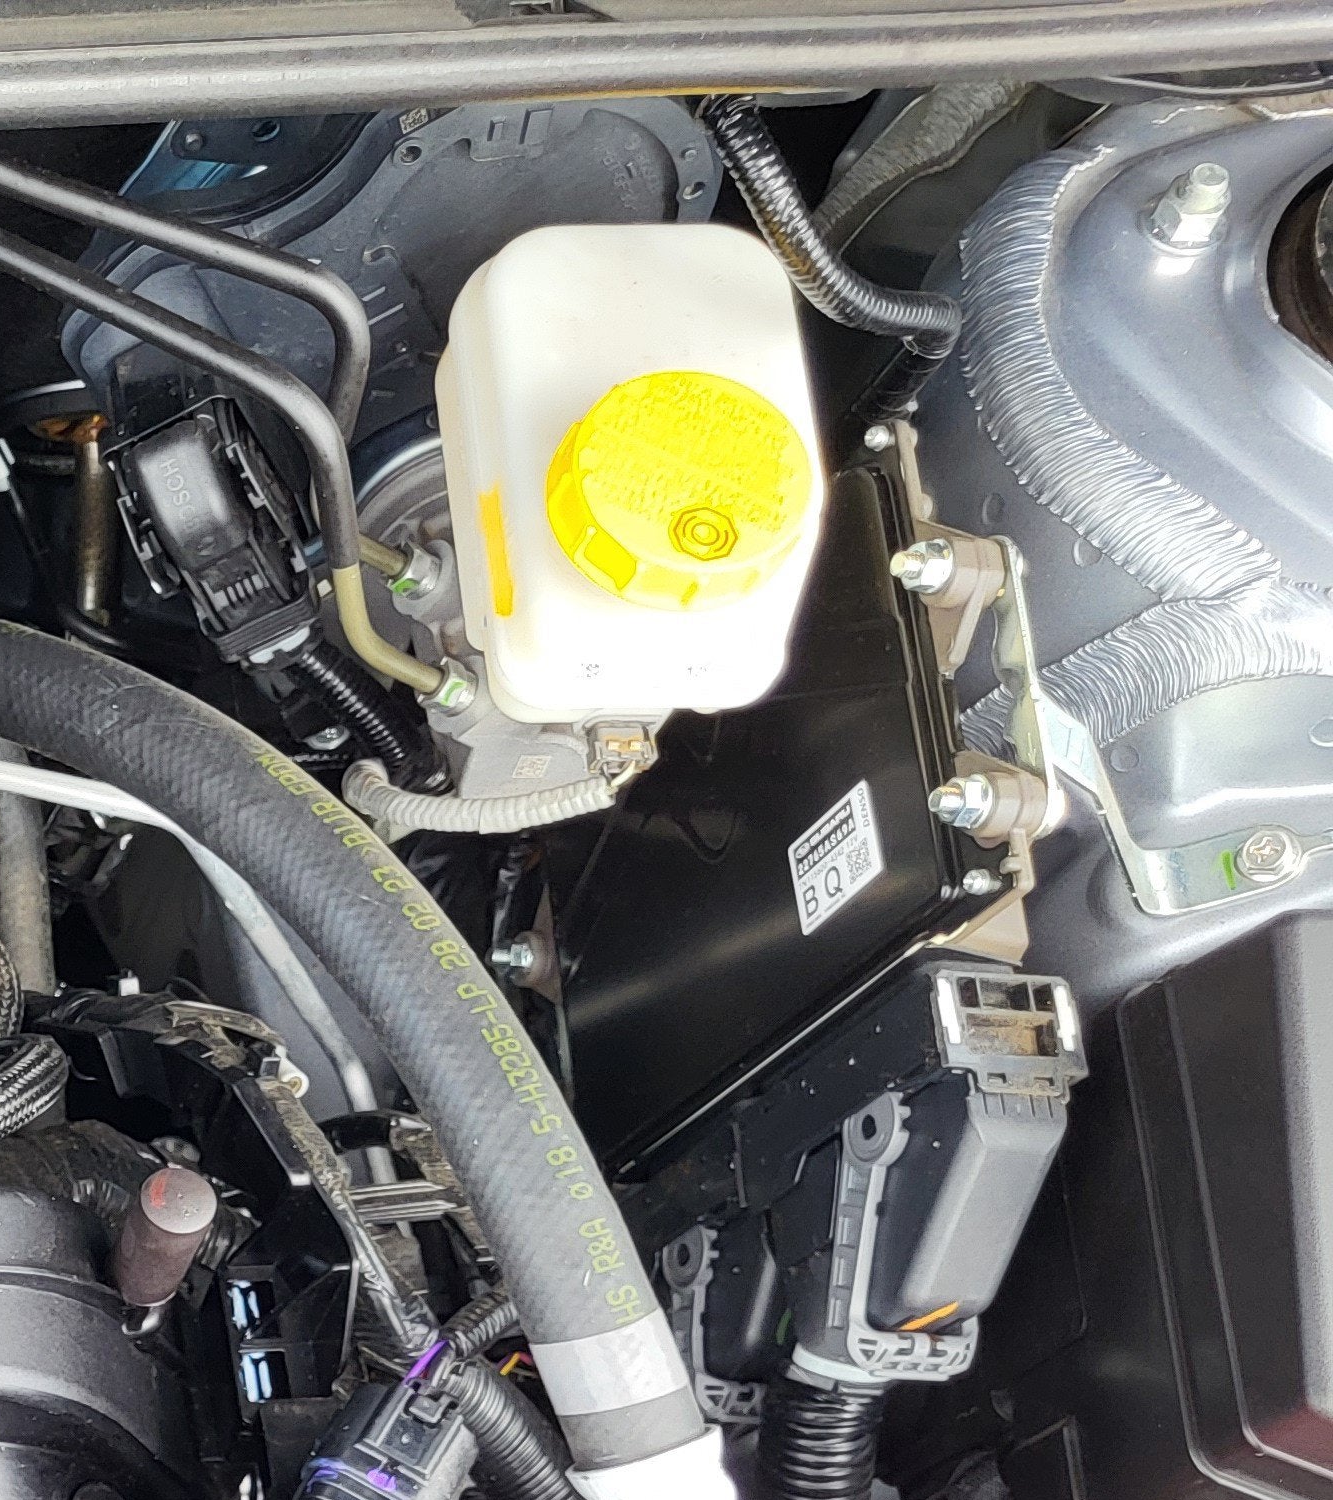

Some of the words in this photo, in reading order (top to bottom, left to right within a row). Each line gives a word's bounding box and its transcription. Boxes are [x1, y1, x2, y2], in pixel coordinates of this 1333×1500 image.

[856, 787, 871, 828] DENSO
[371, 865, 415, 893] 23
[803, 884, 819, 920] B
[824, 865, 844, 899] Q
[430, 939, 471, 970] 28
[605, 1284, 646, 1325] HS
